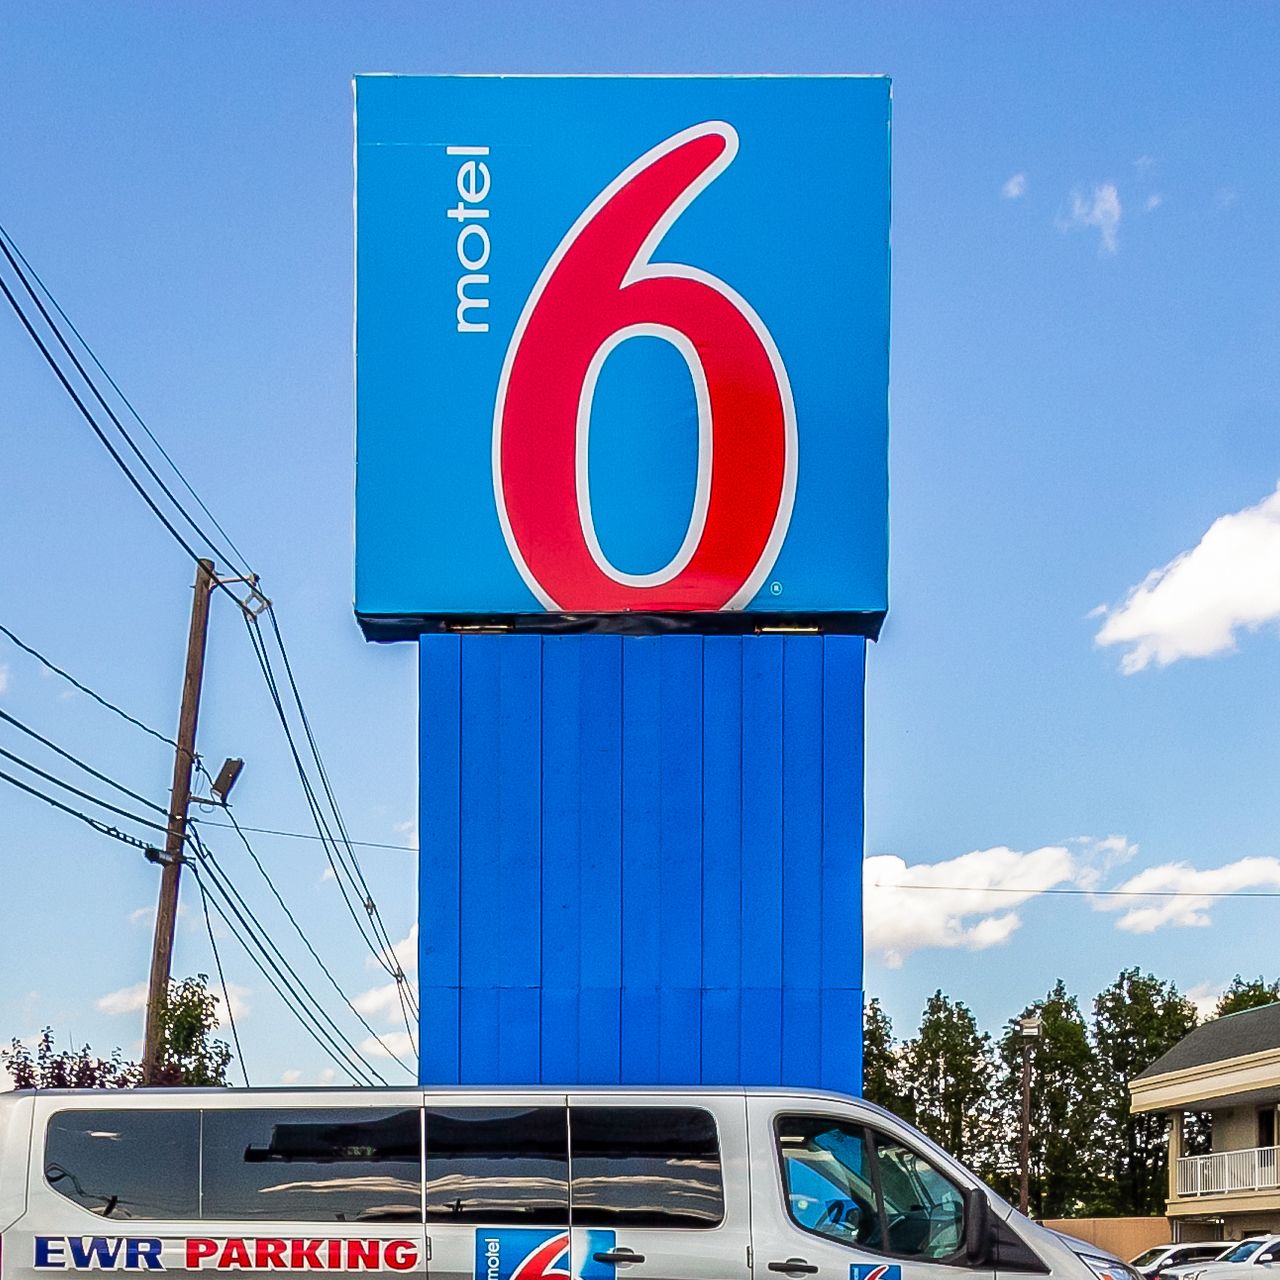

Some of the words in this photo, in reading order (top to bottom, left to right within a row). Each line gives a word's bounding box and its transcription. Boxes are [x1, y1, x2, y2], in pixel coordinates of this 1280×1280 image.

[446, 146, 491, 333] motel
[492, 120, 798, 611] 6
[33, 1235, 165, 1271] EWR
[184, 1237, 420, 1272] PARKING
